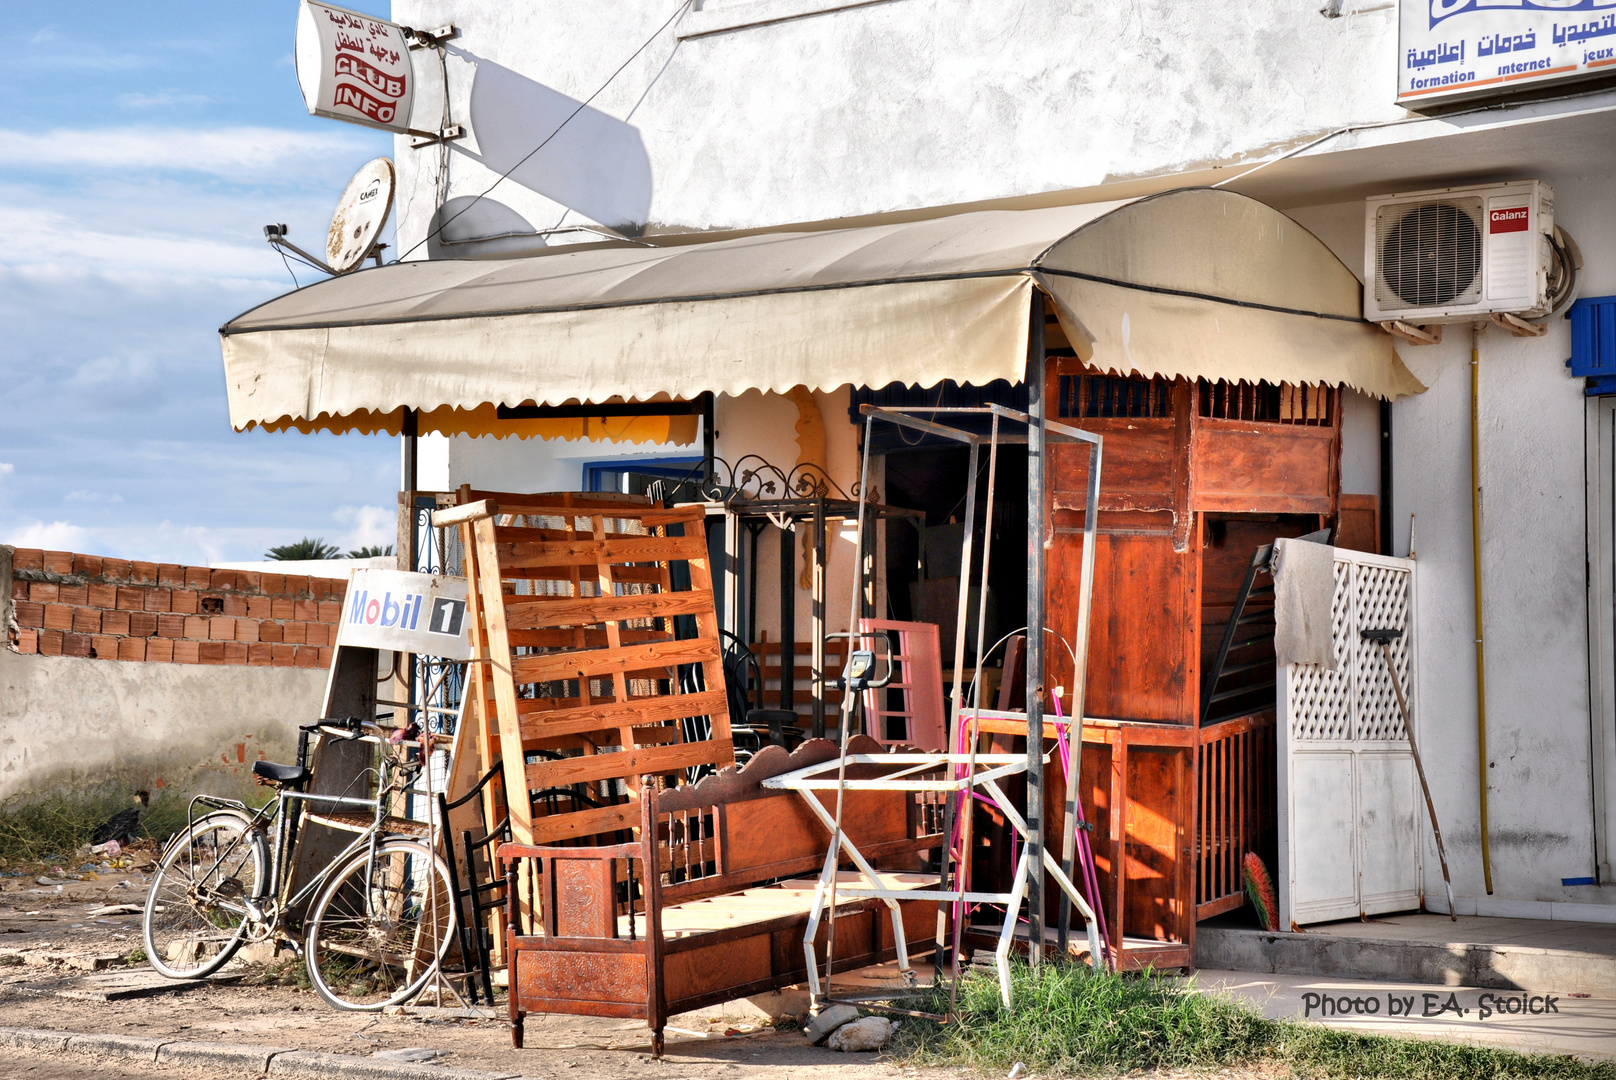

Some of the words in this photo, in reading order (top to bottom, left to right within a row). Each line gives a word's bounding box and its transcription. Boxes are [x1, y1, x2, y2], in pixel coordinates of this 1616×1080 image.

[335, 31, 364, 53] للطفل
[367, 22, 389, 40] نادي
[1477, 28, 1536, 57] خدمات
[336, 56, 402, 97] CLUB
[1411, 70, 1475, 90] formation
[1498, 56, 1551, 76] internet
[1582, 48, 1614, 65] jeux
[337, 87, 394, 122] INFO
[1491, 210, 1527, 221] Galanz
[349, 590, 422, 630] Mobil
[440, 601, 455, 632] 1
